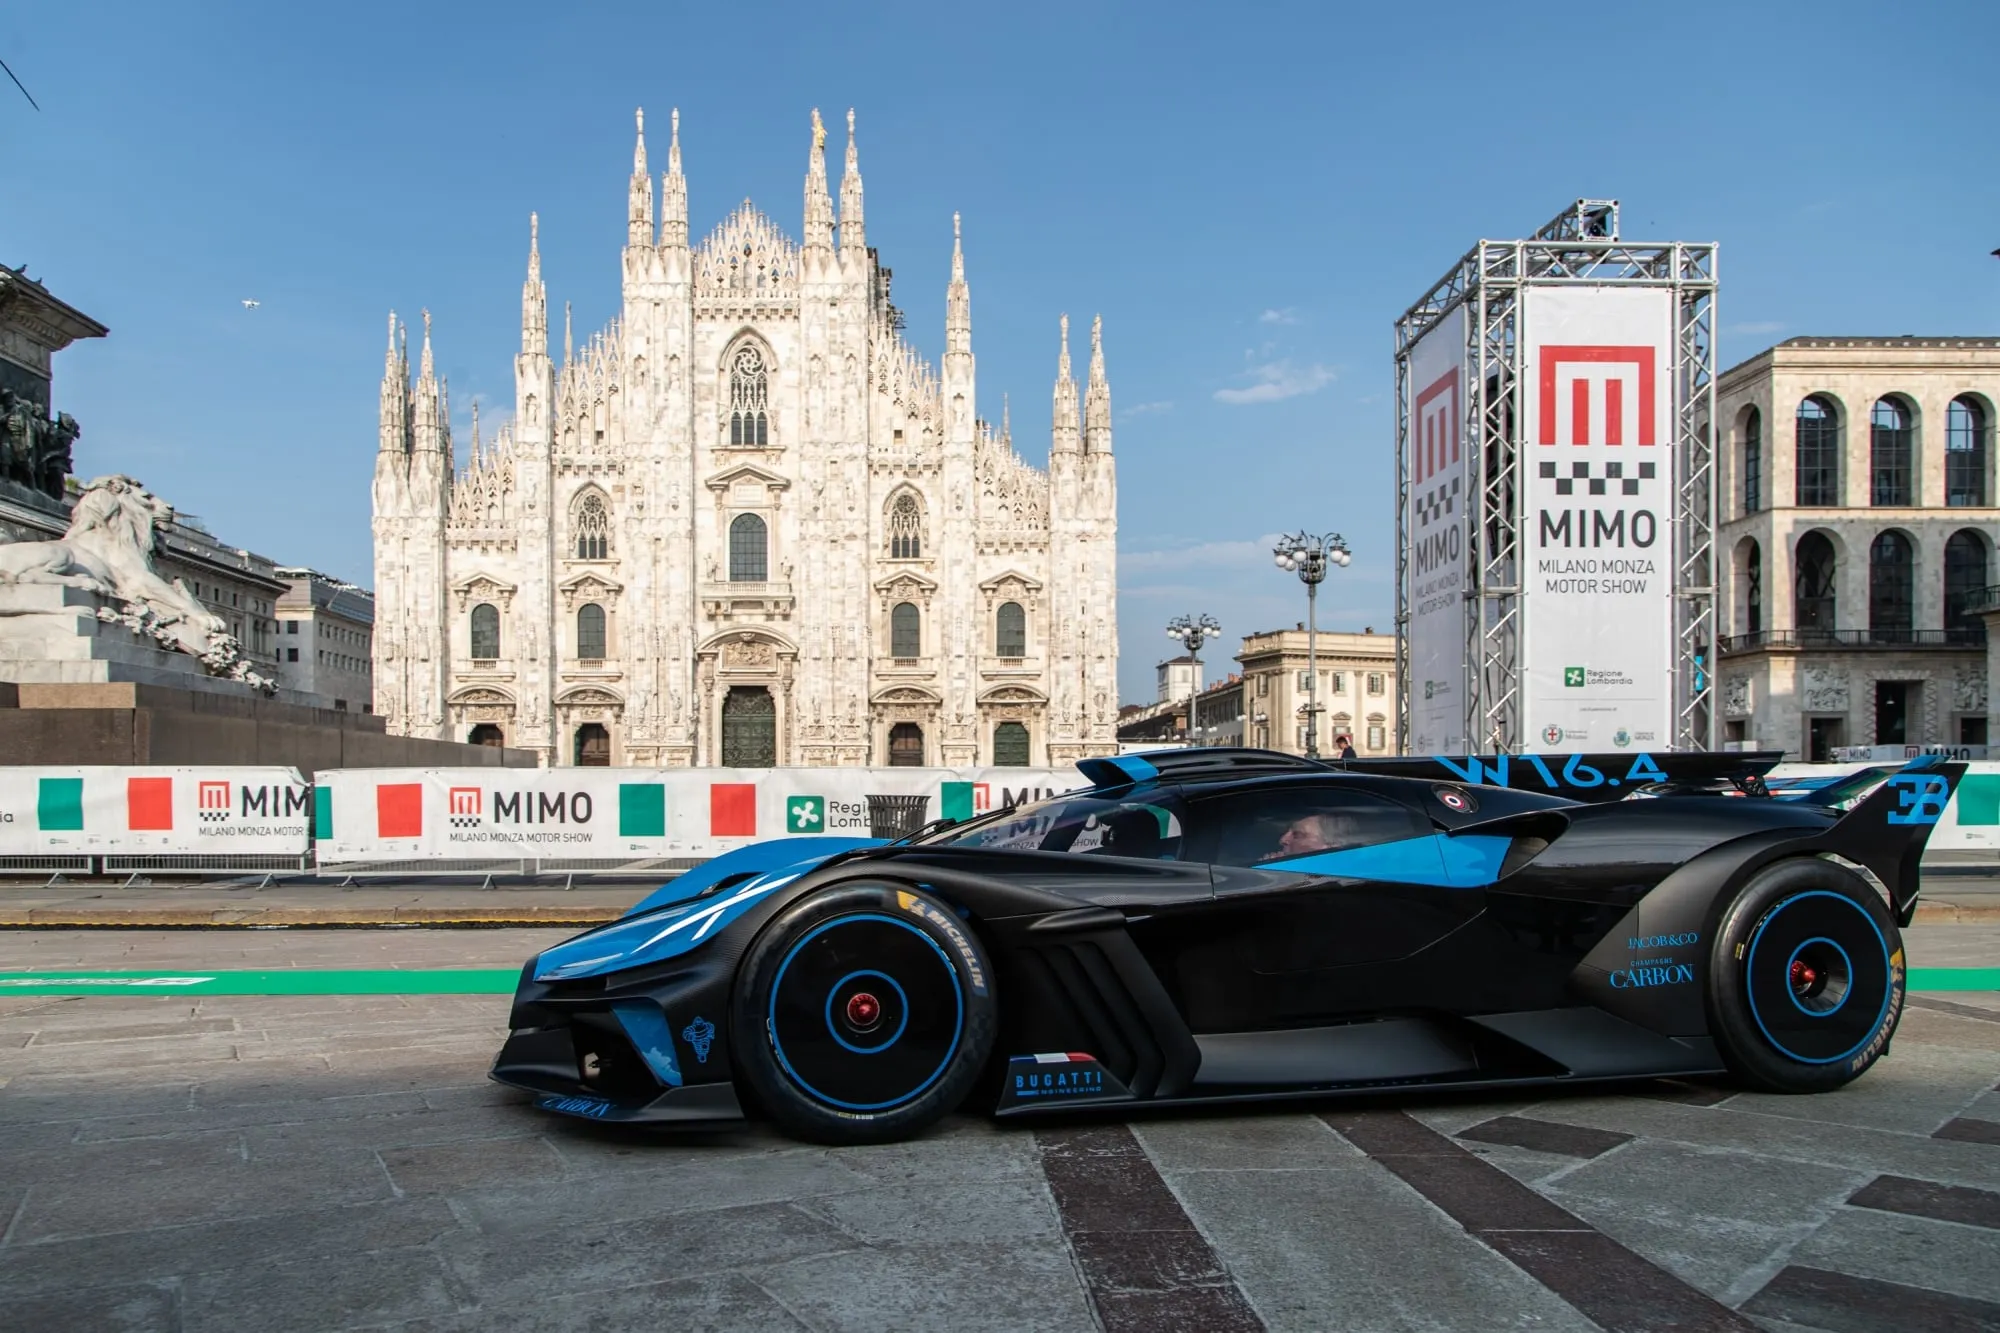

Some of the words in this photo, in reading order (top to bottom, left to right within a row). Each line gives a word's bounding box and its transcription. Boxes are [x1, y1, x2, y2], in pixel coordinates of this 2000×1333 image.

[1540, 509, 1656, 548] MIMO
[1416, 524, 1459, 577] MIMO
[1539, 559, 1597, 574] MILANO
[1601, 559, 1656, 574] MONZA
[1546, 579, 1598, 594] MOTOR
[1601, 579, 1647, 594] SHOW
[1586, 669, 1623, 678] Regione
[1849, 749, 1872, 760] MIMO
[242, 785, 310, 817] MIM
[494, 791, 592, 824] MIMO
[829, 801, 866, 816] Regi
[199, 826, 236, 836] MILANO
[238, 826, 271, 836] MONZA
[274, 826, 304, 836] MOTOR
[450, 832, 487, 842] MILANO
[490, 832, 523, 842] MONZA
[527, 832, 560, 843] MOTOR
[563, 832, 593, 843] SHOW
[927, 910, 984, 987] MICHELIN
[1629, 932, 1698, 949] JACOB&CO
[1630, 957, 1673, 967] CHAMPAGNE
[1610, 964, 1695, 988] CARBON
[1852, 984, 1902, 1072] MICHELIN
[1016, 1071, 1101, 1088] BUGATTI
